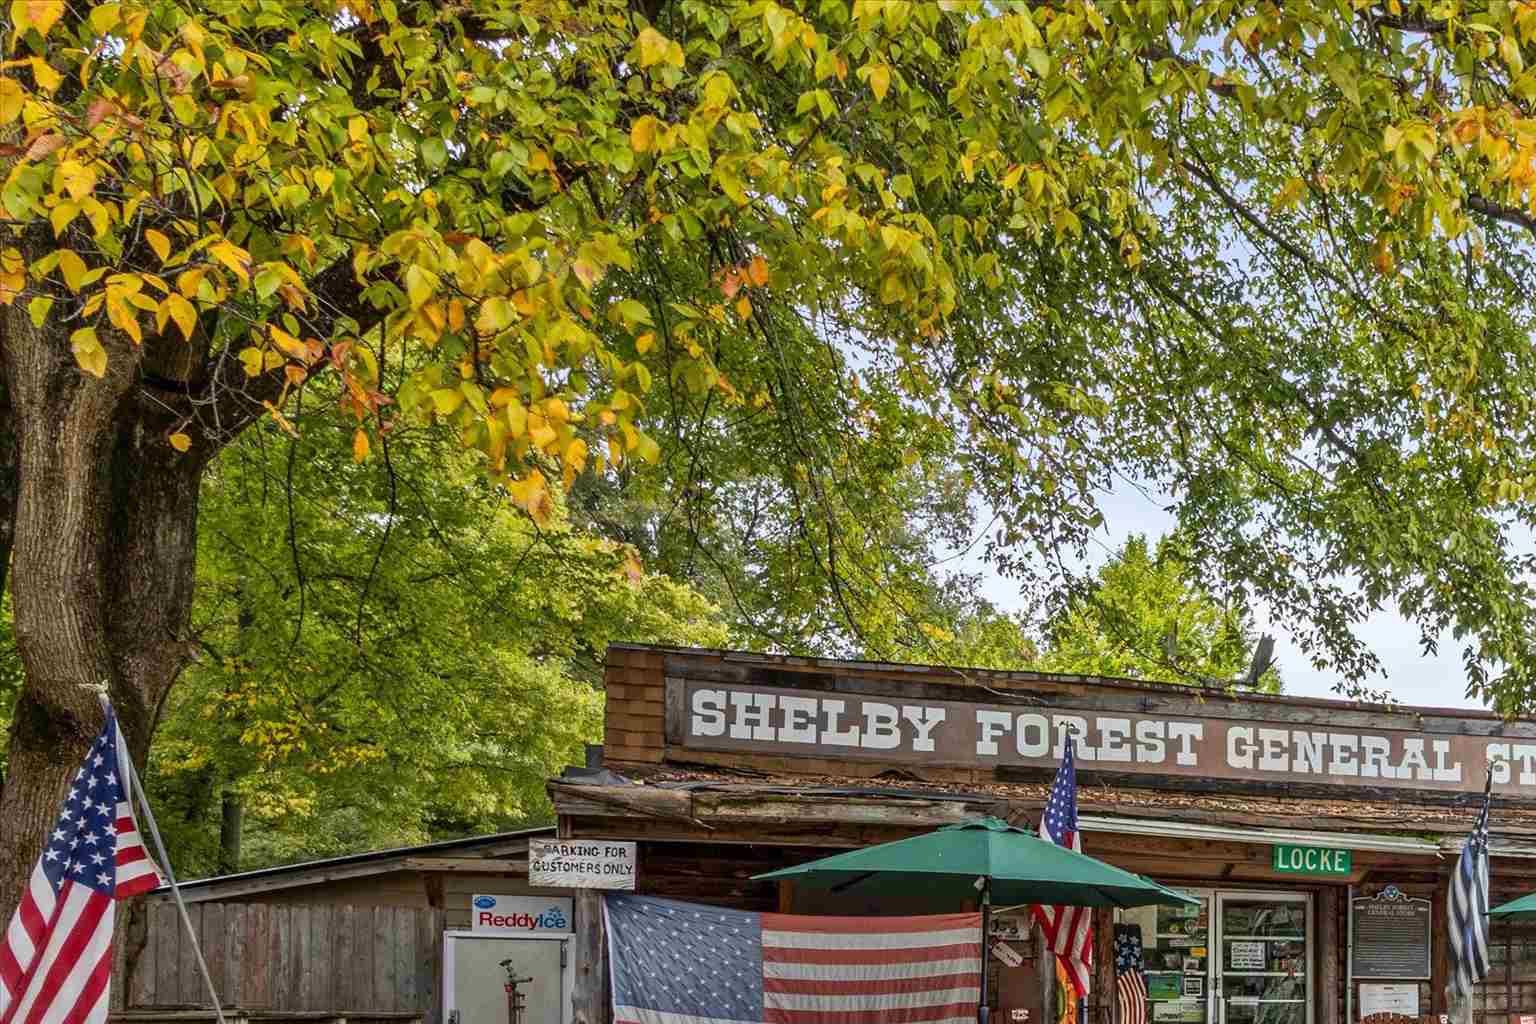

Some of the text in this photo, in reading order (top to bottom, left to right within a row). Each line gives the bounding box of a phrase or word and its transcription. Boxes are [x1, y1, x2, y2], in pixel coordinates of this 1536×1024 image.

[691, 689, 945, 752] SHELBY
[976, 709, 1204, 766] FOREST
[1226, 726, 1462, 783] GENERAL
[543, 845, 626, 858] PARKING FOR
[1278, 847, 1347, 872] LOCKE
[533, 861, 633, 875] CUSTOMERS ONLY
